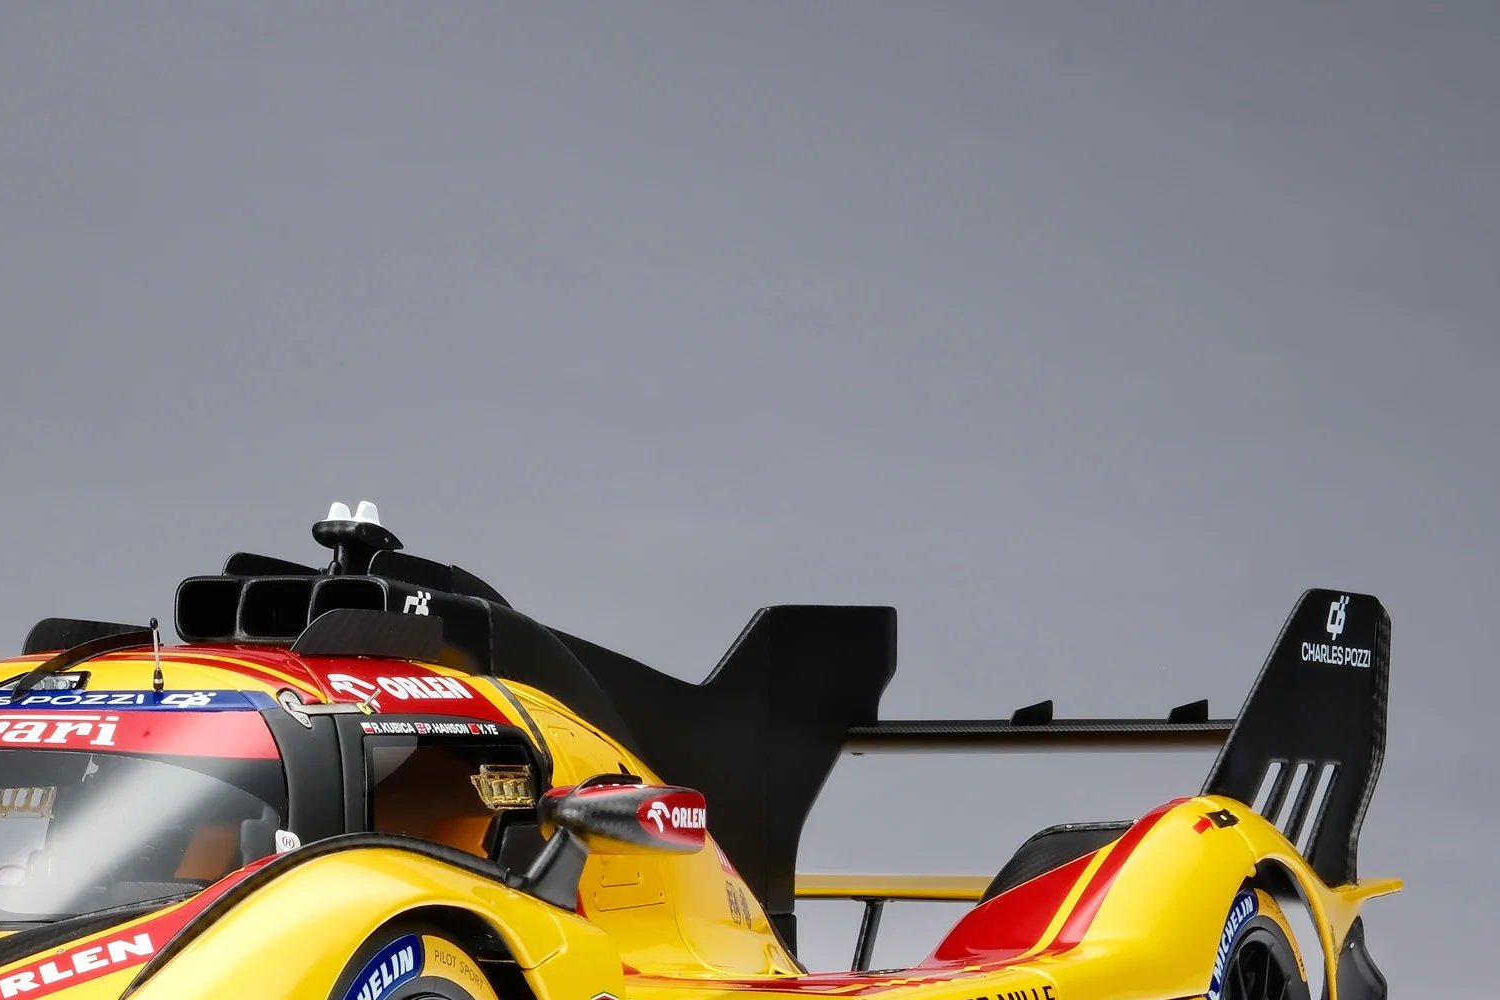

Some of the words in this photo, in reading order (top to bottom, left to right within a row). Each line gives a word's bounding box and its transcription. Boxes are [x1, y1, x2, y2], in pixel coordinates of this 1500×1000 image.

[1302, 642, 1343, 666] CHARLES
[1345, 647, 1371, 668] POZZI
[29, 693, 145, 706] POZZI
[376, 677, 473, 700] ORLEN
[373, 721, 416, 735] R.KUBICA
[426, 723, 469, 735] P.HANSON
[478, 724, 499, 735] Y.YE
[671, 806, 706, 829] ORLEN
[1213, 895, 1254, 985] MICHELIN
[434, 949, 457, 969] PILOT
[459, 961, 484, 990] SPORT
